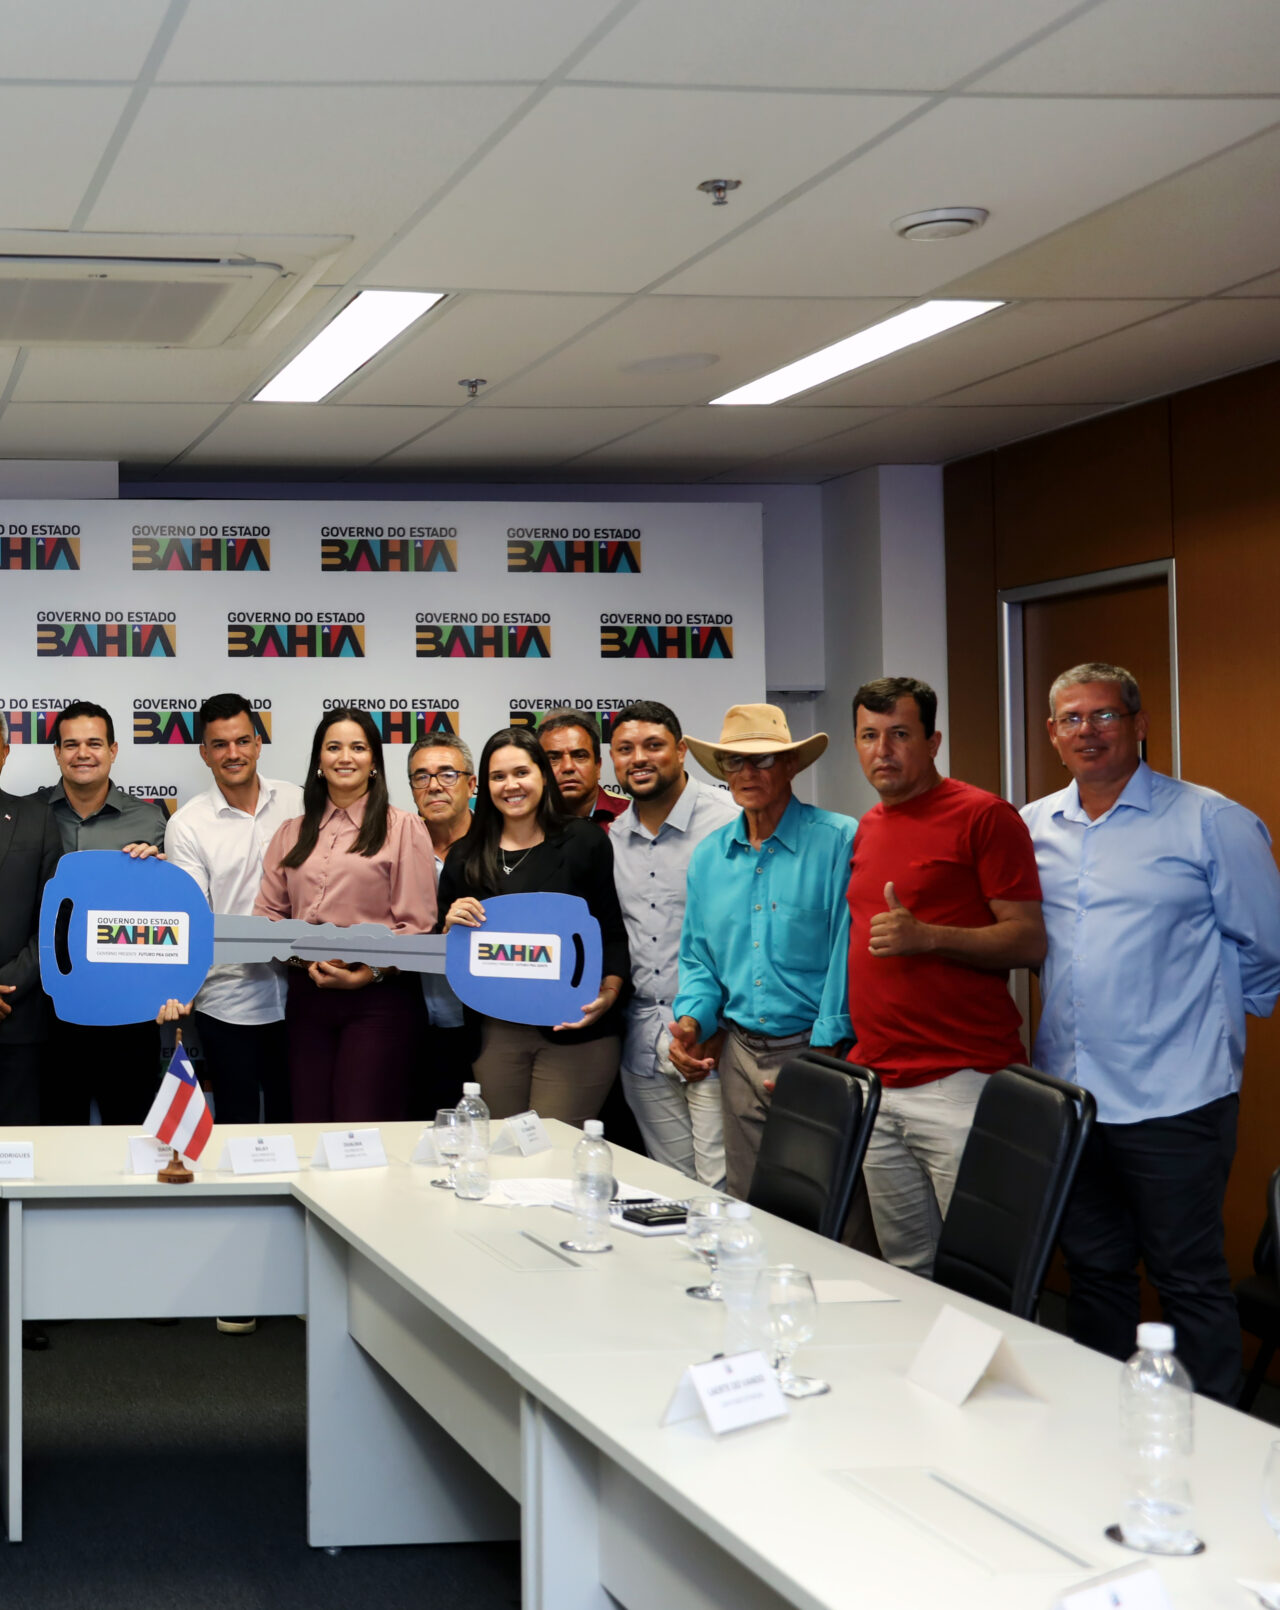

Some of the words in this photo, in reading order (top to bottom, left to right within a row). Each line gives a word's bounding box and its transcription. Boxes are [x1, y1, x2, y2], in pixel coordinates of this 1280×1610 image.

[8, 524, 28, 536] DO
[31, 524, 80, 536] ESTADO
[132, 525, 196, 536] GOVERNO
[199, 525, 219, 536] DO
[221, 525, 270, 536] ESTADO
[320, 526, 385, 538] GOVERNO
[387, 526, 407, 538] DO
[409, 526, 458, 538] ESTADO
[506, 528, 569, 540] GOVERNO
[572, 528, 591, 540] DO
[593, 528, 641, 540] ESTADO
[132, 538, 270, 571] BAHIA
[321, 540, 457, 572] BAHIA
[507, 541, 640, 572] BAHIA
[36, 611, 102, 623] GOVERNO
[105, 611, 124, 623] DO
[127, 611, 177, 623] ESTADO
[227, 612, 292, 624] GOVERNO
[294, 612, 314, 624] DO
[316, 612, 366, 624] ESTADO
[415, 613, 479, 624] GOVERNO
[481, 613, 501, 624] DO
[503, 613, 551, 624] ESTADO
[600, 614, 662, 625] GOVERNO
[665, 614, 684, 625] DO
[686, 614, 734, 625] ESTADO
[37, 624, 176, 657] BAHIA
[228, 625, 365, 657] BAHIA
[416, 626, 551, 658] BAHIA
[600, 626, 733, 658] BAHIA
[9, 698, 29, 710] DO
[133, 698, 197, 710] GOVERNO
[322, 698, 386, 710] GOVERNO
[389, 698, 408, 710] DO
[411, 698, 460, 710] ESTADO
[509, 698, 571, 710] GOVERNO
[574, 698, 593, 710] DO
[595, 698, 642, 710] ESTAD
[368, 712, 459, 744] HIA
[128, 786, 178, 796] ESTADO
[97, 917, 135, 925] GOVERNO
[150, 918, 180, 926] ESTADO
[97, 925, 179, 945] BAHIA
[478, 943, 552, 963] BAHIA
